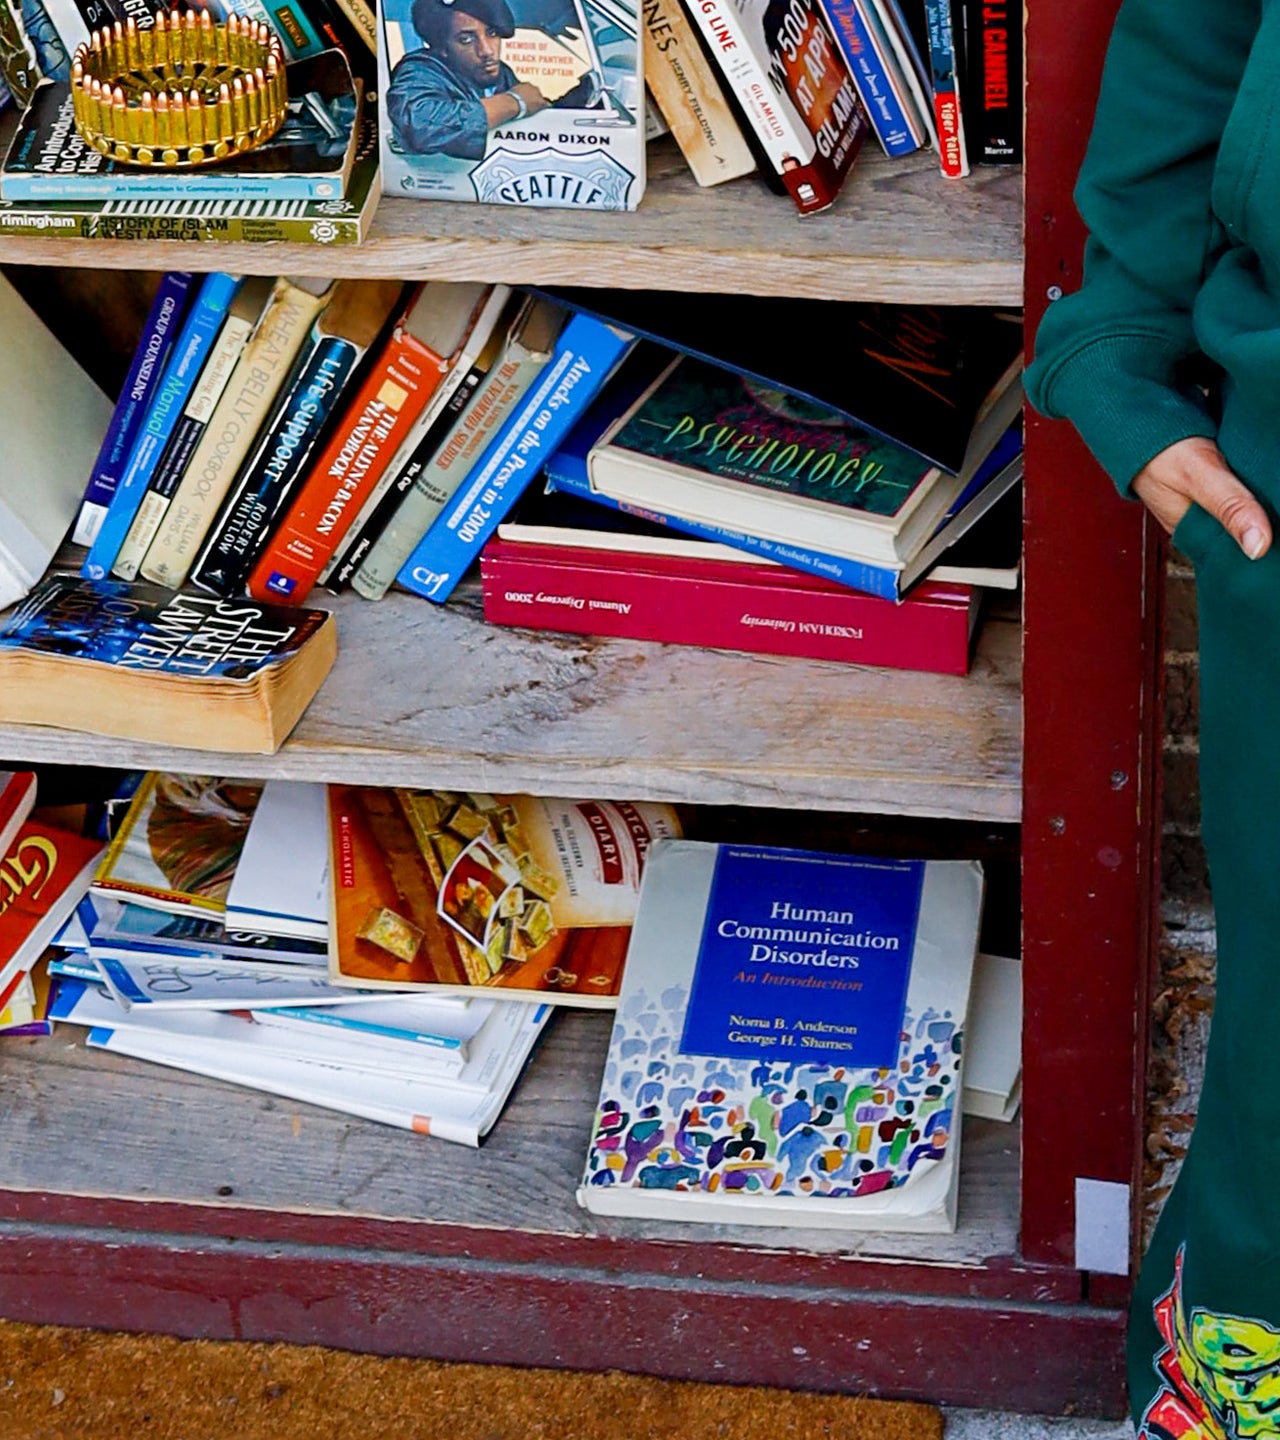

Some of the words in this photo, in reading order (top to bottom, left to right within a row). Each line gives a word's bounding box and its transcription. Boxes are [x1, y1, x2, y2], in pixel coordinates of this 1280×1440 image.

[538, 55, 574, 65] PANTHER
[541, 67, 574, 77] CAPTAIN
[707, 14, 737, 54] LINE
[749, 81, 764, 100] GIL
[758, 99, 785, 138] AMELIO
[980, 26, 1010, 110] CANNELL
[668, 57, 693, 96] HENRY
[687, 96, 718, 148] FIELDING
[795, 55, 817, 116] AT
[493, 129, 551, 143] AARON
[558, 132, 611, 146] DIXON
[938, 101, 958, 134] tiger
[944, 135, 961, 166] tales
[984, 146, 1014, 155] Morrow
[500, 173, 603, 205] SEATTLE
[94, 217, 157, 229] HISTORY
[159, 218, 180, 229] OF
[182, 218, 230, 230] ISLAM
[101, 229, 148, 241] WEST
[150, 230, 201, 241] AFRICA
[152, 295, 176, 335] GROUP
[255, 296, 304, 370] WHEAT
[174, 332, 203, 379] Publication
[225, 328, 243, 349] The
[129, 331, 164, 403] COUNSELING
[204, 349, 233, 392] Teaching
[305, 354, 343, 401] LIFE
[545, 352, 594, 416] Attacks
[146, 375, 189, 441] Manual
[189, 393, 213, 420] Gap
[228, 365, 270, 424] BELLY
[461, 373, 506, 435] UNCOMMON
[326, 395, 385, 484] HANDBOOK
[531, 406, 555, 432] on
[190, 417, 241, 503] COOKBOOK
[259, 396, 319, 486] SUPPORT
[433, 427, 470, 474] SOLDIER
[514, 427, 543, 458] the
[664, 415, 885, 495] PSYCHOLOGY
[490, 450, 527, 494] Press
[216, 488, 258, 557] WHITLOW
[314, 486, 351, 538] BACON
[455, 502, 492, 546] 2000
[773, 544, 813, 565] Alcoholic
[811, 556, 844, 577] Family
[504, 590, 533, 603] 2000
[534, 591, 585, 609] Directory
[588, 599, 631, 614] Alumni
[117, 593, 222, 669] LAWYER
[179, 600, 263, 674] STREET
[220, 607, 296, 663] THE
[740, 613, 796, 632] University
[798, 621, 863, 638] FORDHAM
[337, 824, 355, 887] SCHOLASTIC
[590, 815, 617, 867] DIARY
[717, 918, 900, 951] Communication
[770, 900, 855, 927] Human
[749, 944, 860, 970] Disorders
[732, 969, 757, 985] An
[761, 971, 865, 992] Introduction
[727, 1029, 778, 1048] George
[780, 1032, 797, 1048] H.
[800, 1034, 854, 1052] Shames
[729, 1014, 772, 1031] Noma
[774, 1016, 789, 1031] B.
[793, 1017, 858, 1036] Anderson
